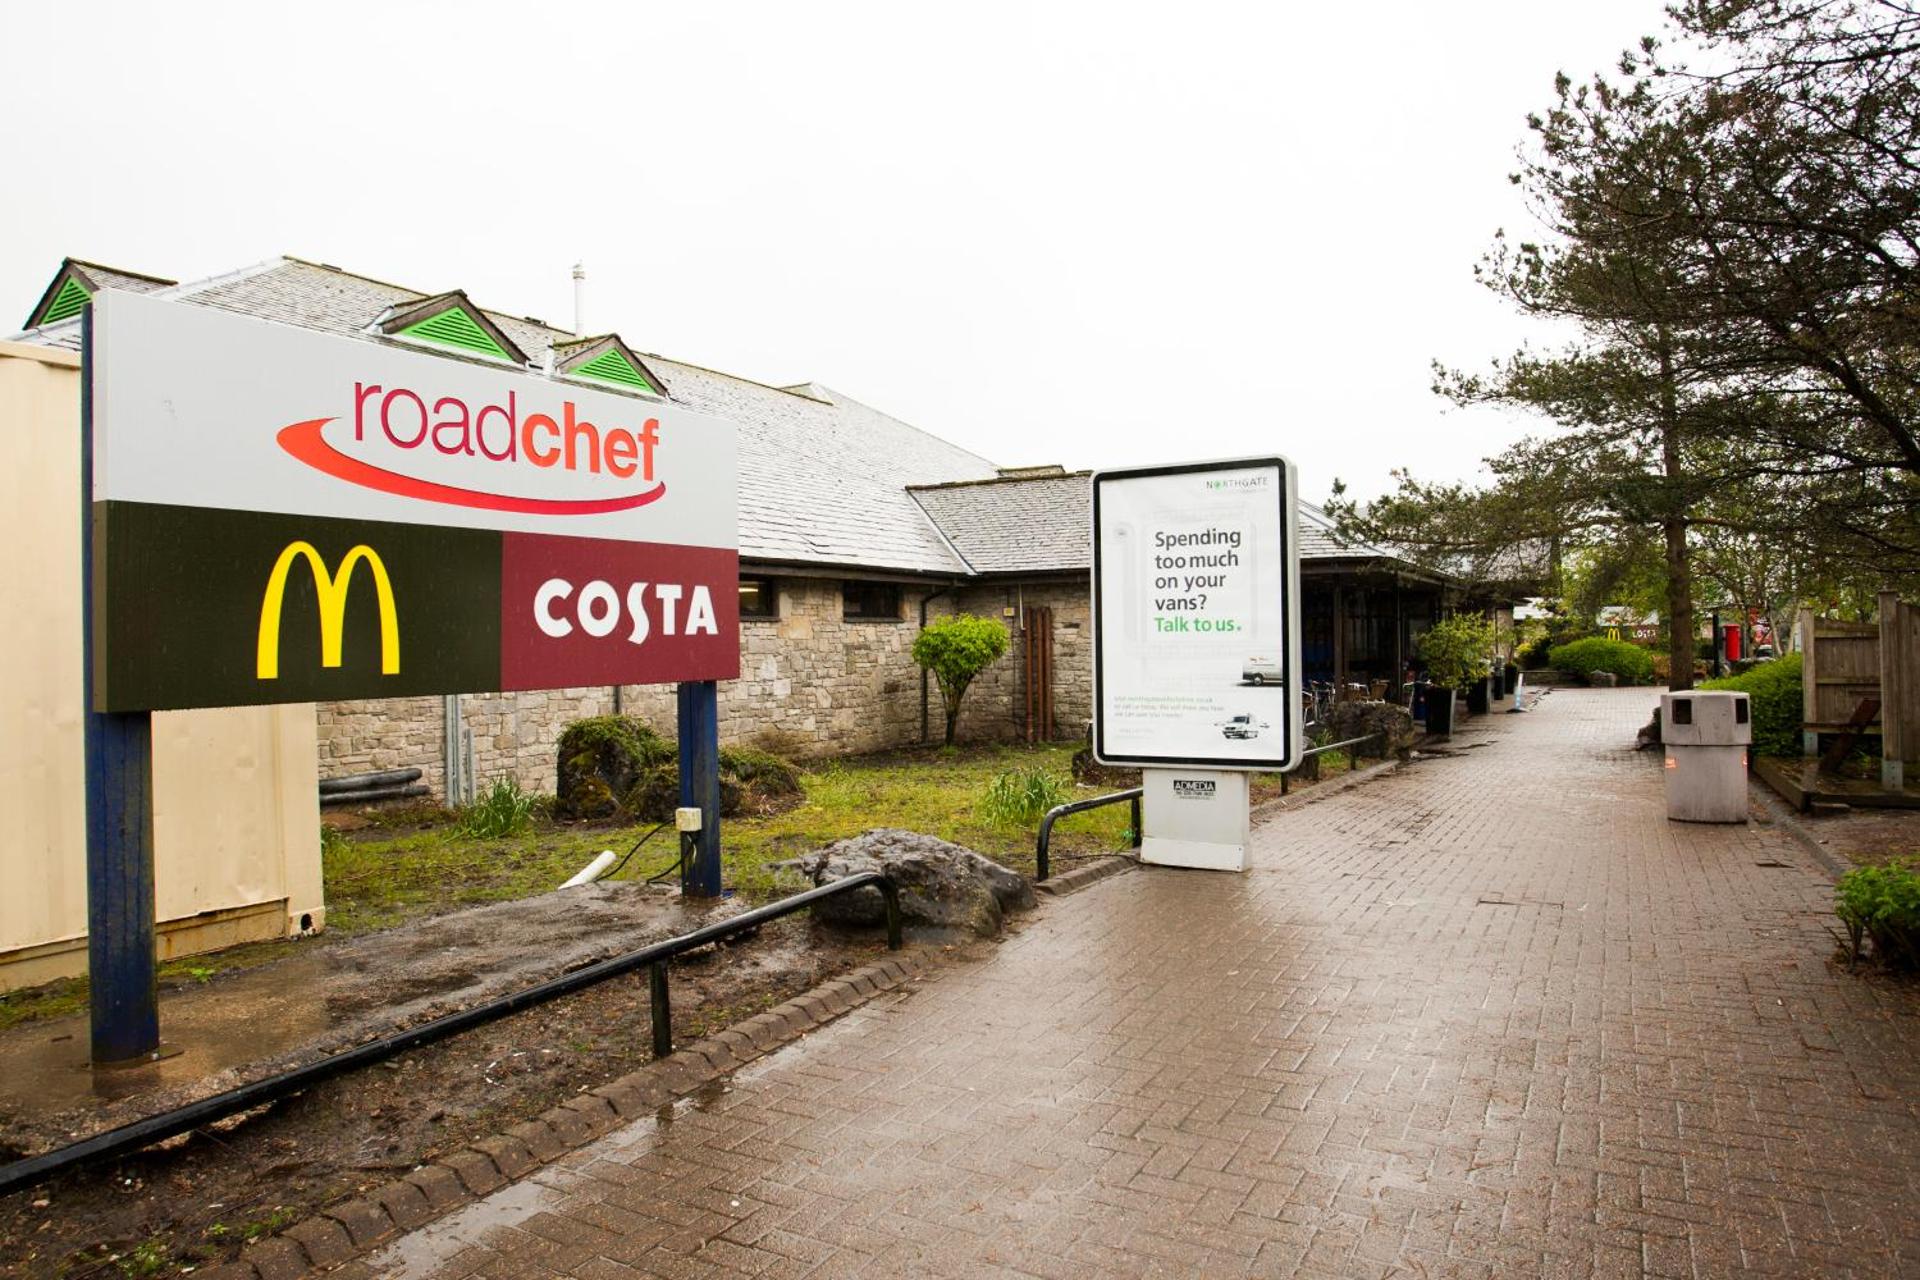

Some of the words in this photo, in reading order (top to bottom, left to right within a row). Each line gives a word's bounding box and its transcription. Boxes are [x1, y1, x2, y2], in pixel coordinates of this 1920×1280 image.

[354, 382, 660, 481] roadchef
[1155, 528, 1241, 551] Spending
[1155, 555, 1186, 569] too
[1189, 550, 1239, 568] much
[1155, 577, 1178, 589] on
[1184, 575, 1226, 592] your
[533, 578, 718, 644] COSTA
[1155, 594, 1207, 611] vans?
[1154, 616, 1189, 632] Talk
[1194, 618, 1212, 632] to
[1216, 619, 1242, 632] us.
